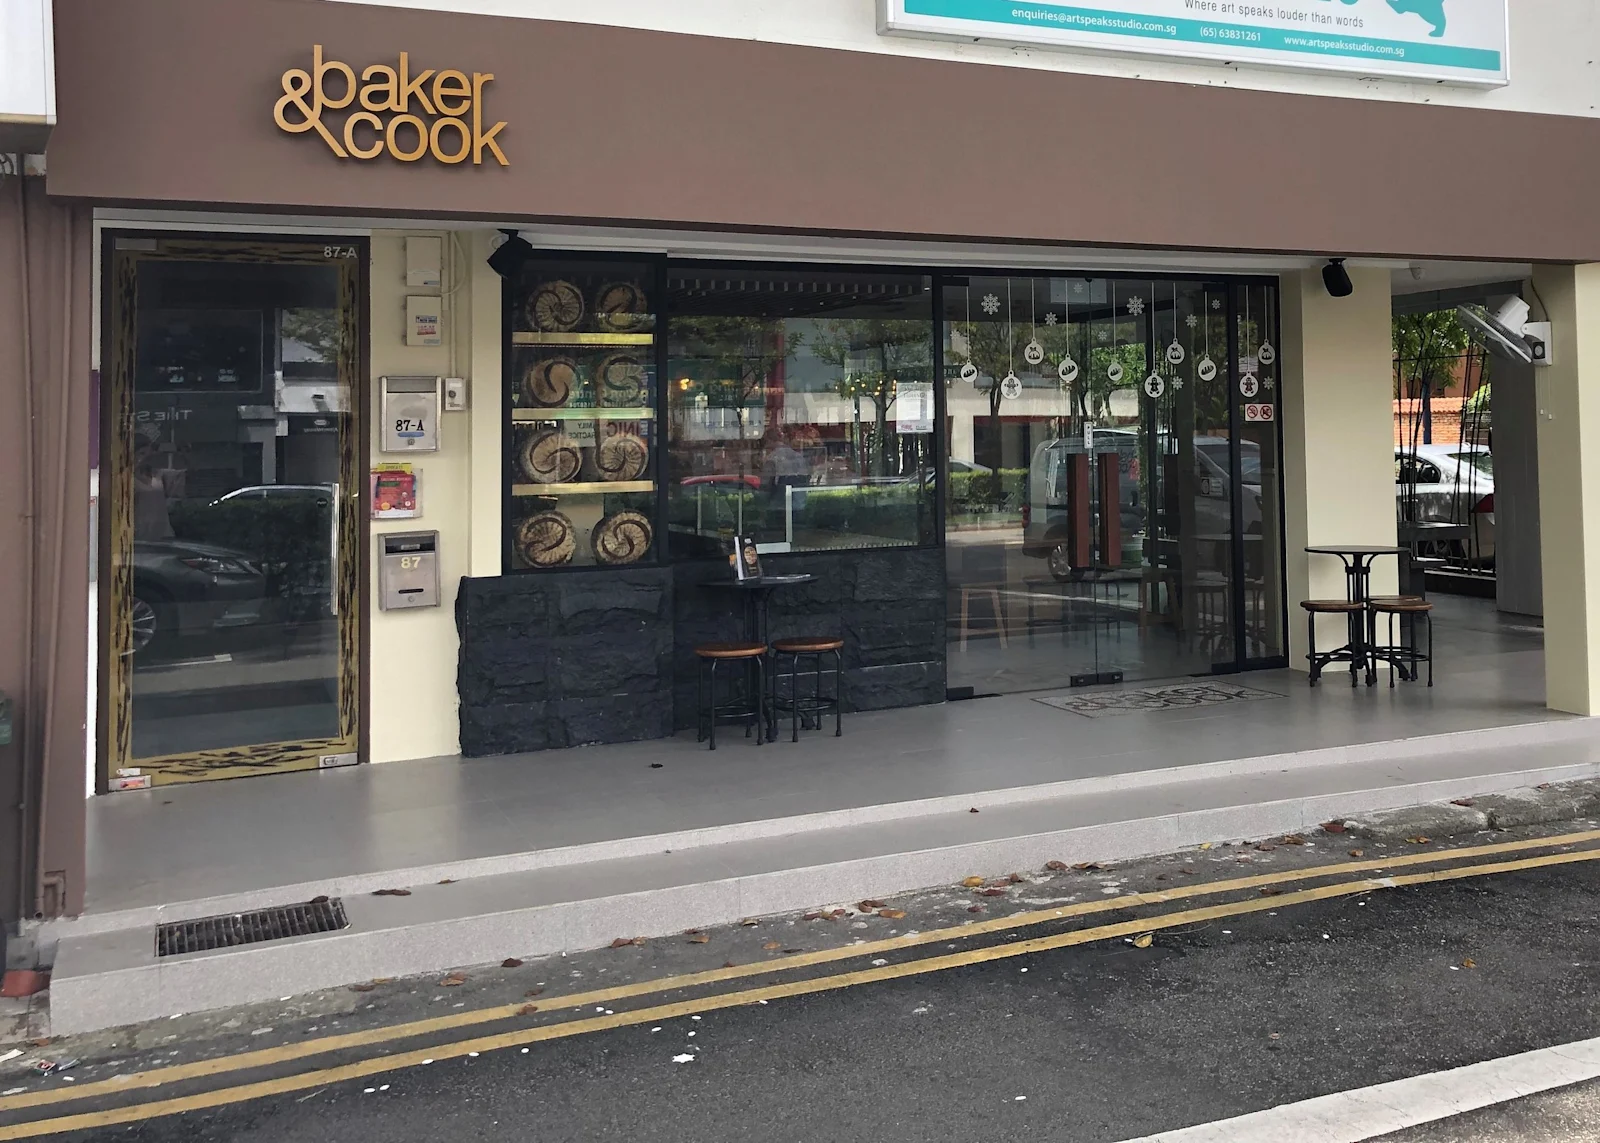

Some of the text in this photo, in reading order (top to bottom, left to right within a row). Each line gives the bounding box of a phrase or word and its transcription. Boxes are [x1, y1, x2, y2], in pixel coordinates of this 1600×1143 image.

[1011, 8, 1177, 36] enquiries@artspeaksstudio.com.sg
[1185, 0, 1364, 28] Where art speaks louder than words
[1200, 26, 1261, 42] (65) 63831261
[1284, 35, 1405, 57] www.artspeaksstudio.com.sg
[313, 44, 495, 117] baker
[343, 111, 511, 166] cook
[323, 246, 358, 259] 87-A
[395, 419, 424, 432] 87-A
[401, 557, 421, 568] 87
